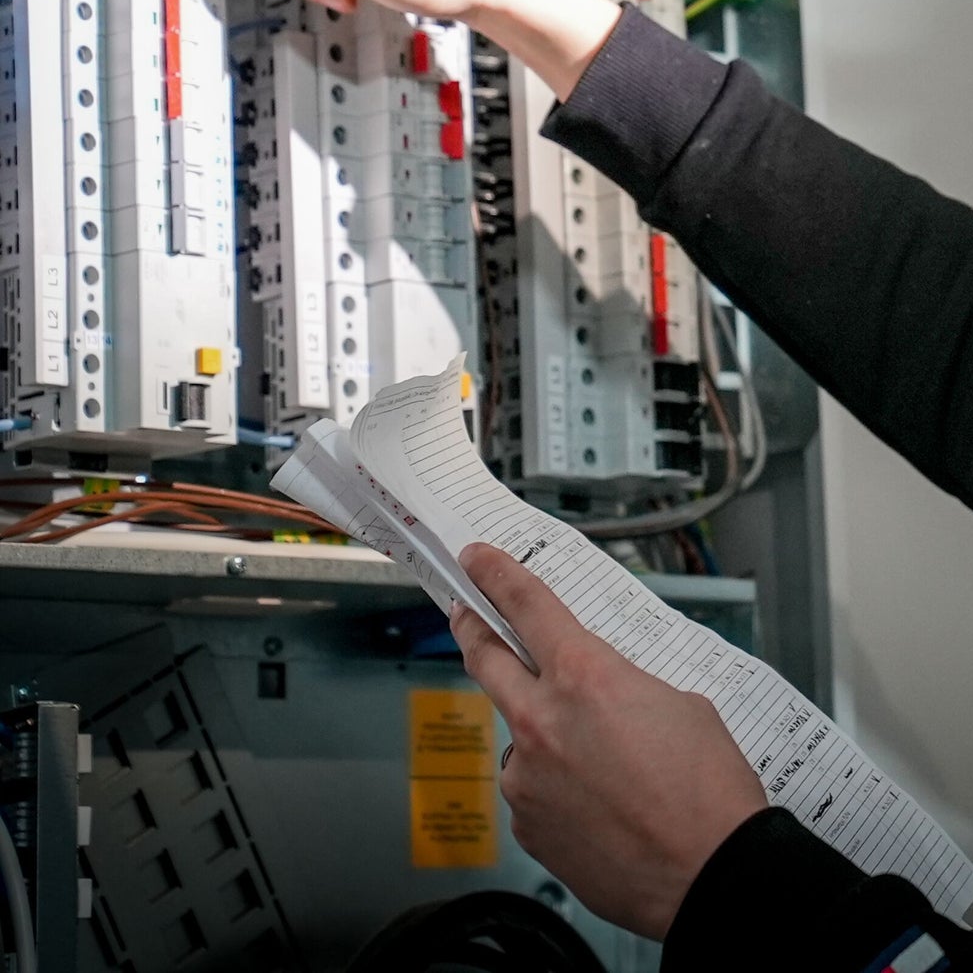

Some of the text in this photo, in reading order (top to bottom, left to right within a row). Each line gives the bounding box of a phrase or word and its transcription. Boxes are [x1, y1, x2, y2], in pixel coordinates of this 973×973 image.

[48, 267, 60, 373] L1 L2 L3
[308, 333, 319, 352] L2
